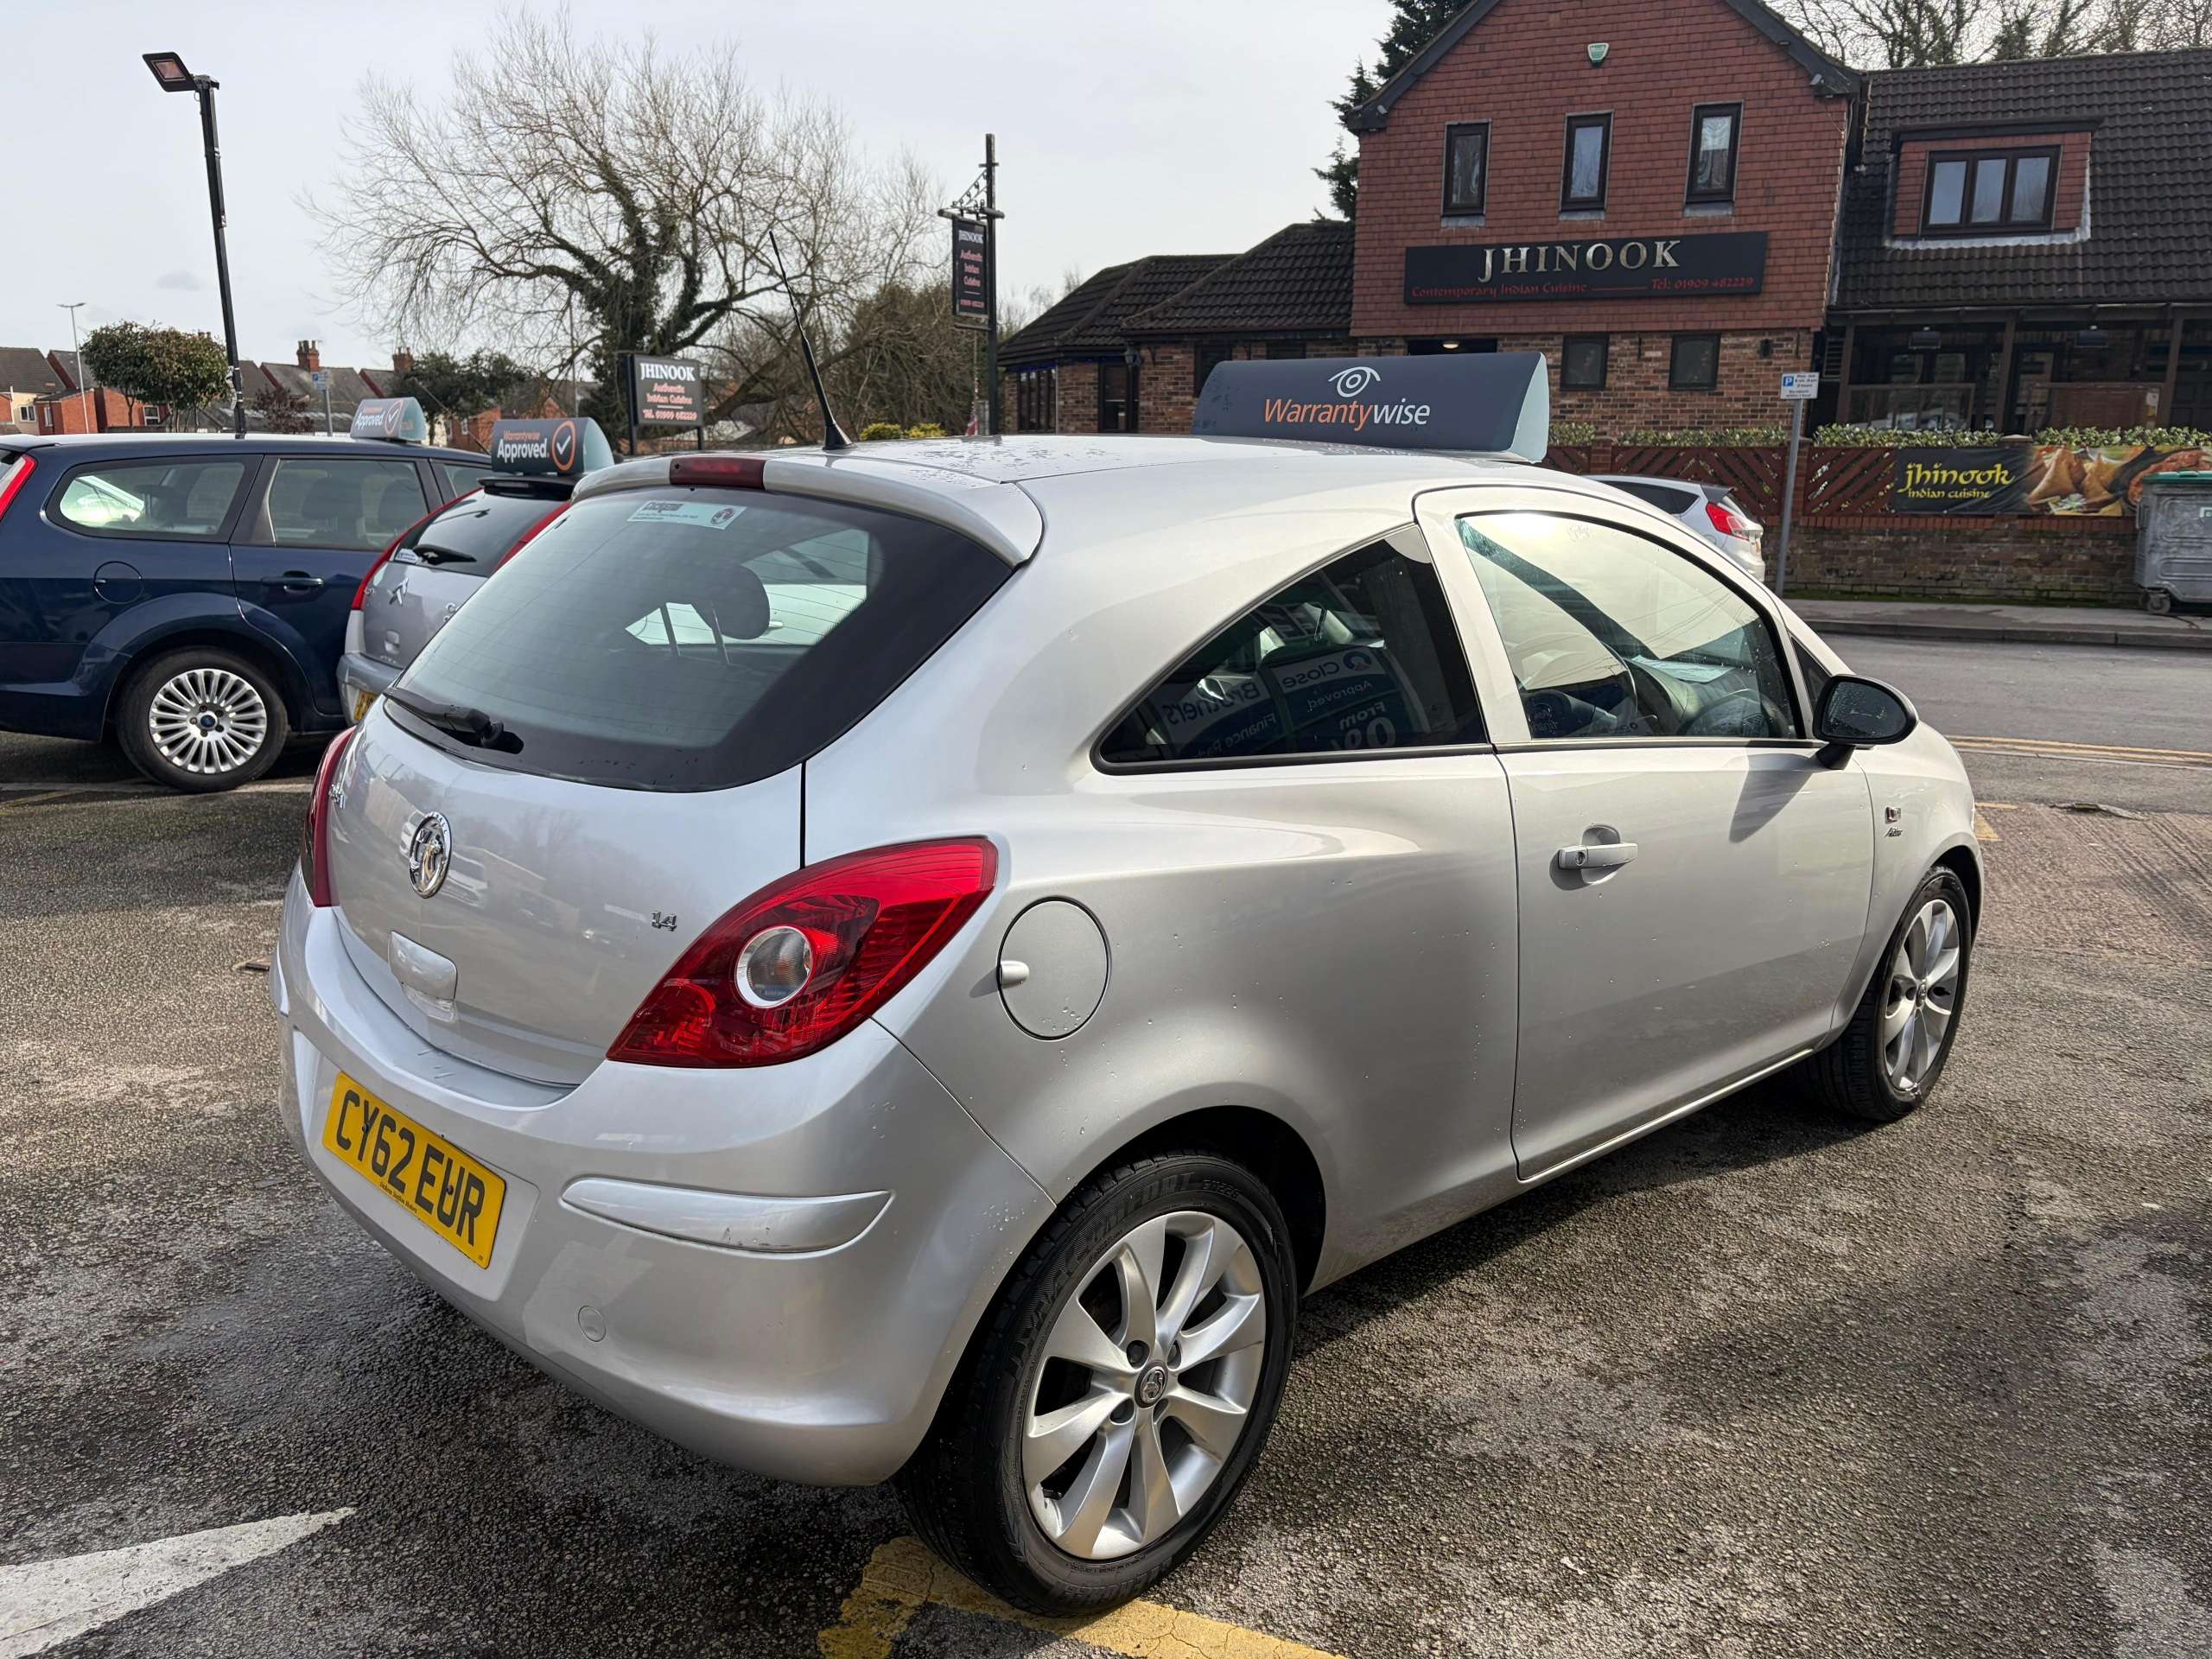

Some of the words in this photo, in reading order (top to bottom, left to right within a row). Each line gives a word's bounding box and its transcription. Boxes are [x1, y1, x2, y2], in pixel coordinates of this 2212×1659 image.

[1478, 239, 1681, 283] JHINOOK
[1411, 286, 1497, 298] Contemporary
[1501, 283, 1539, 296] Indian
[1542, 282, 1586, 293] Cuisine
[1652, 277, 1671, 290] Tel:
[1675, 279, 1709, 289] 01909
[640, 363, 696, 381] JHINOOK
[1263, 398, 1431, 431] Warrantywise
[1897, 463, 2015, 493] jhinook
[1908, 488, 1944, 499] indian
[1948, 488, 1992, 499] cuisine
[336, 1089, 416, 1194] CY62
[415, 1143, 486, 1247] EUR
